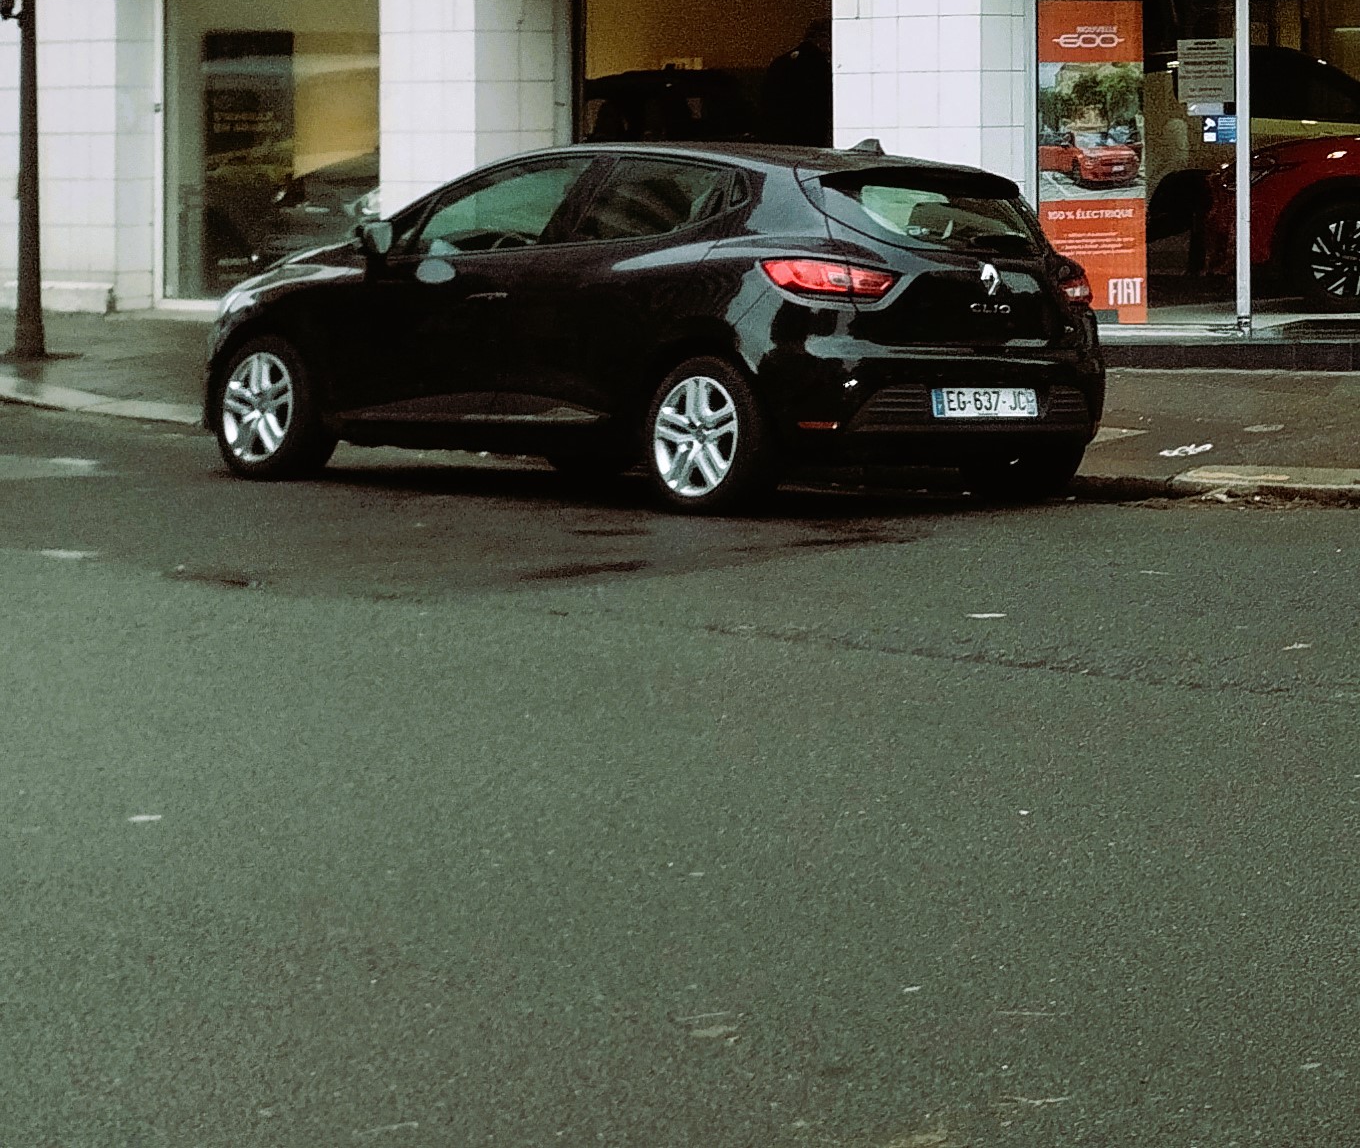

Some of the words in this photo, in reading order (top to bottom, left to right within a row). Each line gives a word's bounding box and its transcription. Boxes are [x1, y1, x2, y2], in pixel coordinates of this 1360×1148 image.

[1059, 34, 1119, 48] 600
[1108, 277, 1144, 306] FIAT
[969, 303, 1011, 315] CLIO
